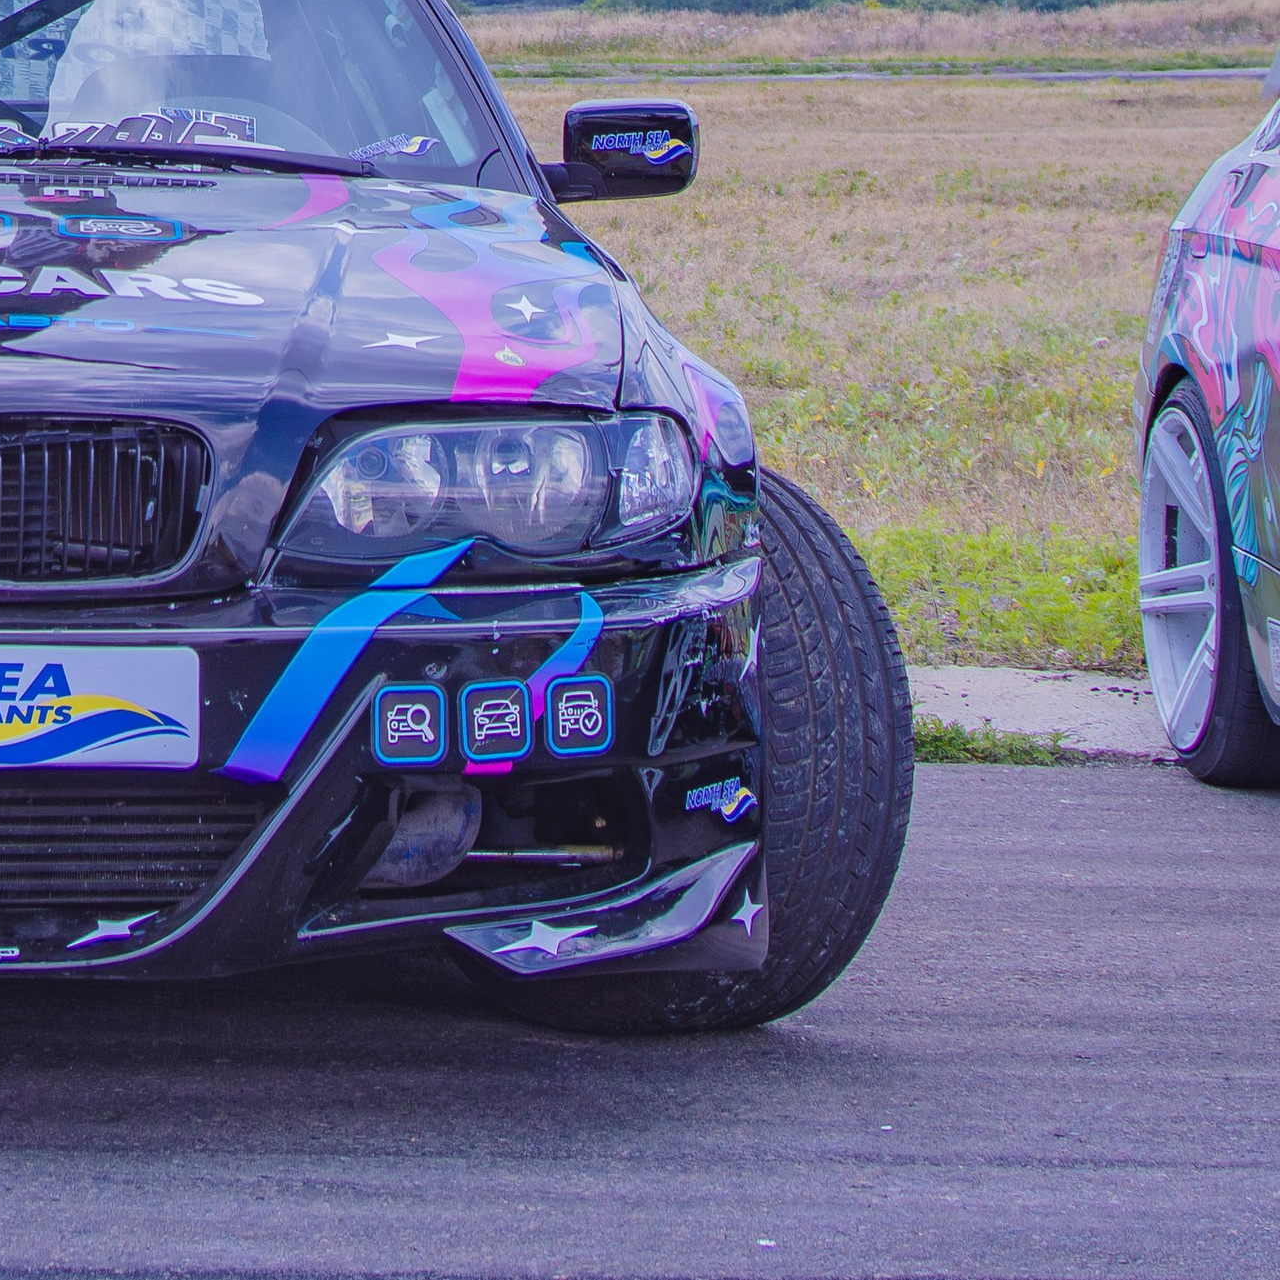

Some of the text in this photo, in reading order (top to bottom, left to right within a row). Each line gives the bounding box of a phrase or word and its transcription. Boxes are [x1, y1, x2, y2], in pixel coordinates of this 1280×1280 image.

[592, 129, 671, 151] NORTH SEA
[685, 781, 723, 811] NORTH
[722, 776, 741, 799] SEA
